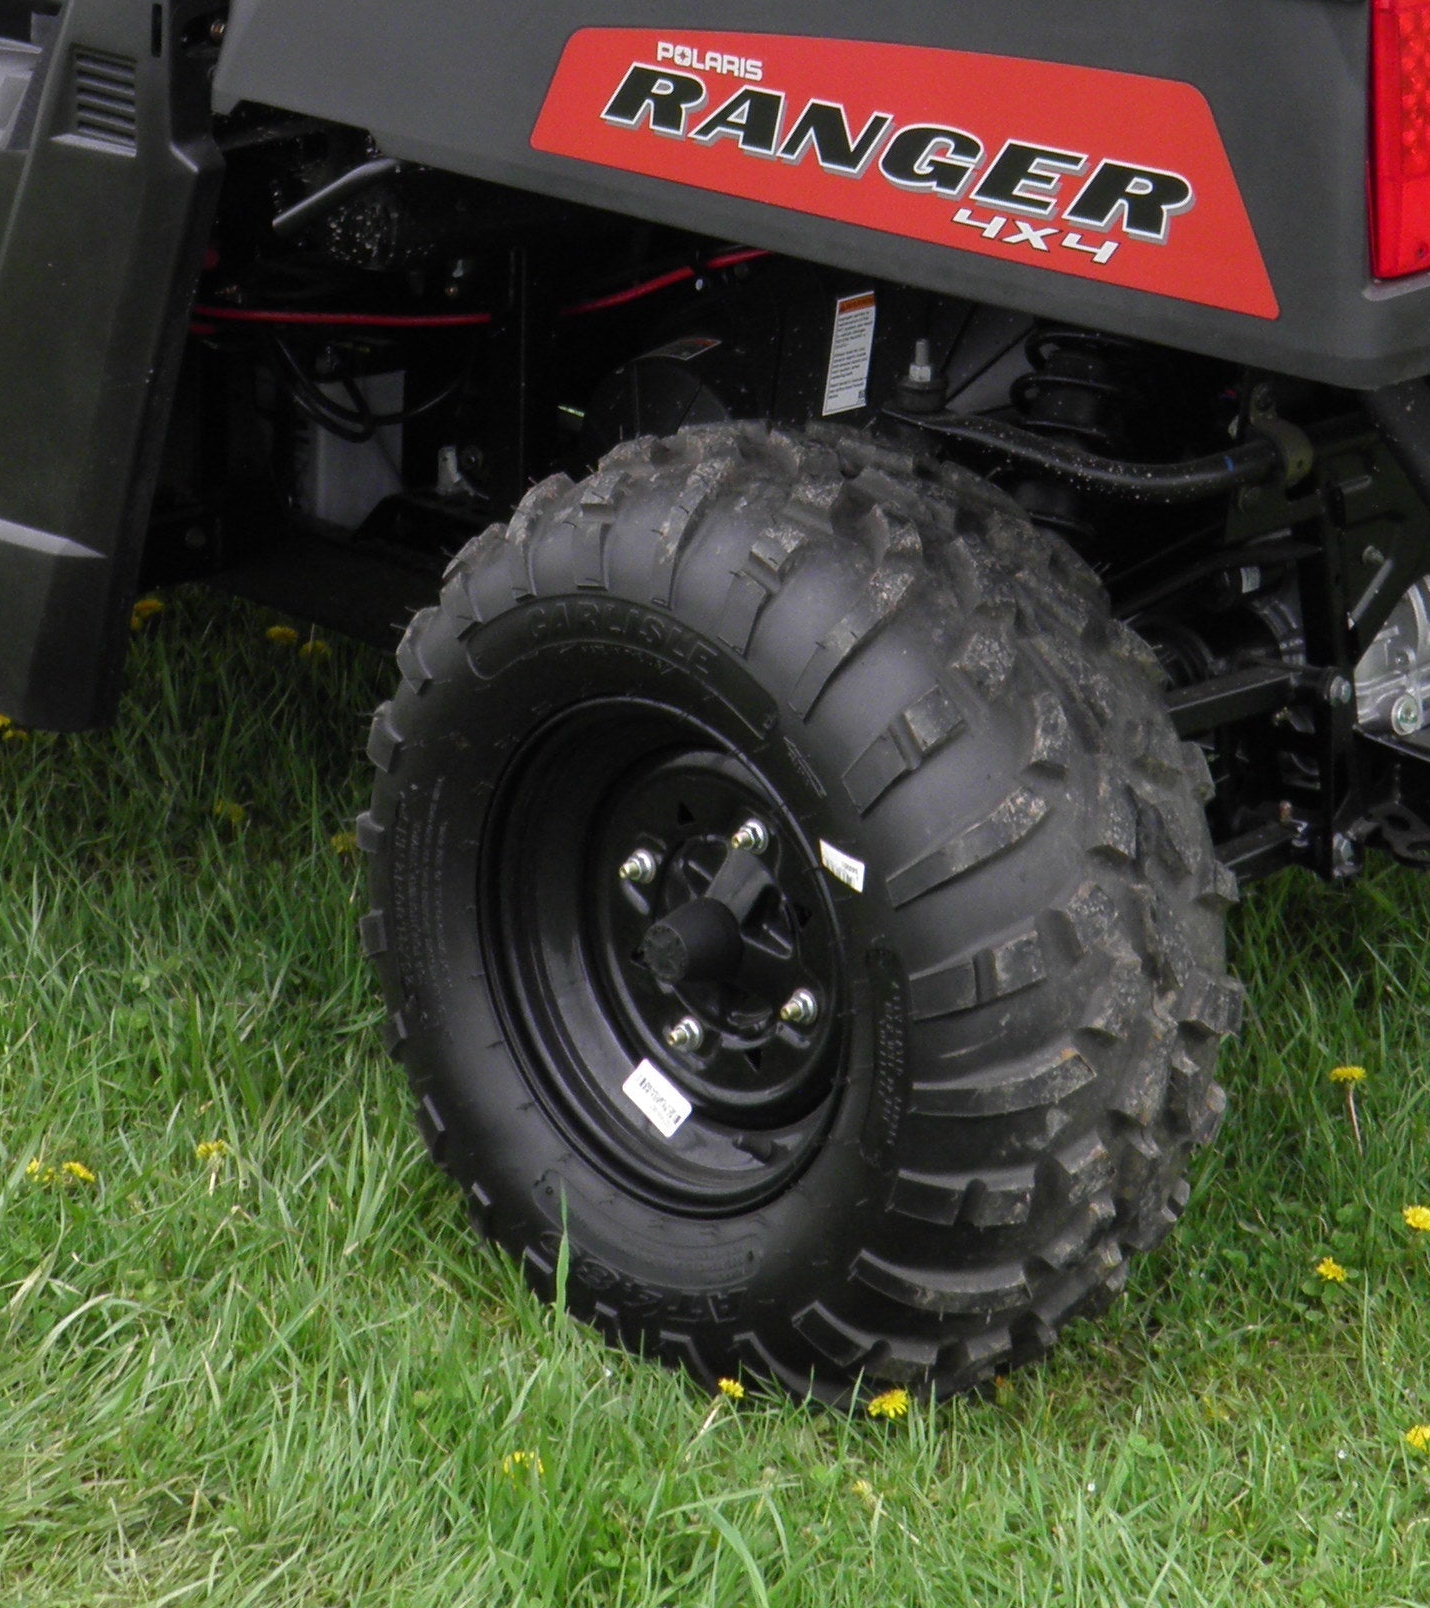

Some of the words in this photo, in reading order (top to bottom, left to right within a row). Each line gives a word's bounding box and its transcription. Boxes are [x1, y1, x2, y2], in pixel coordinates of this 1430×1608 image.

[656, 41, 763, 81] POLARIS
[600, 61, 1195, 244] RANGER
[525, 601, 719, 675] CARLISLE
